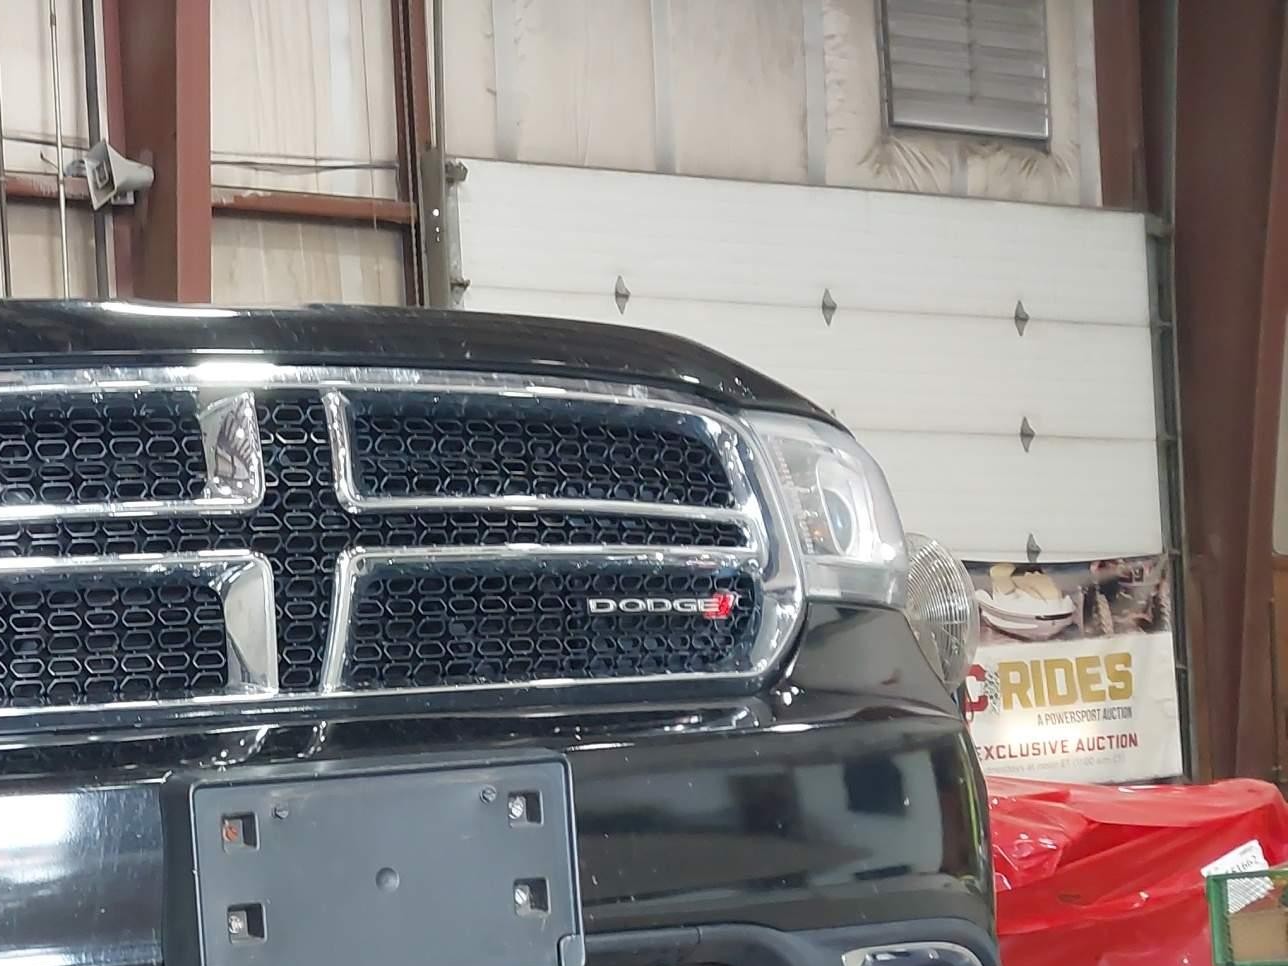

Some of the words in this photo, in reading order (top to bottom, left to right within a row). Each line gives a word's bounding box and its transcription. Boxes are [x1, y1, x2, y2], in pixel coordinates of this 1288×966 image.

[589, 598, 720, 613] DODGE
[998, 652, 1133, 710] RIDES
[1037, 713, 1044, 726] A
[1045, 708, 1101, 726] POWERSPORT
[1103, 706, 1133, 721] AUCTION
[1076, 733, 1139, 753] AUCTION
